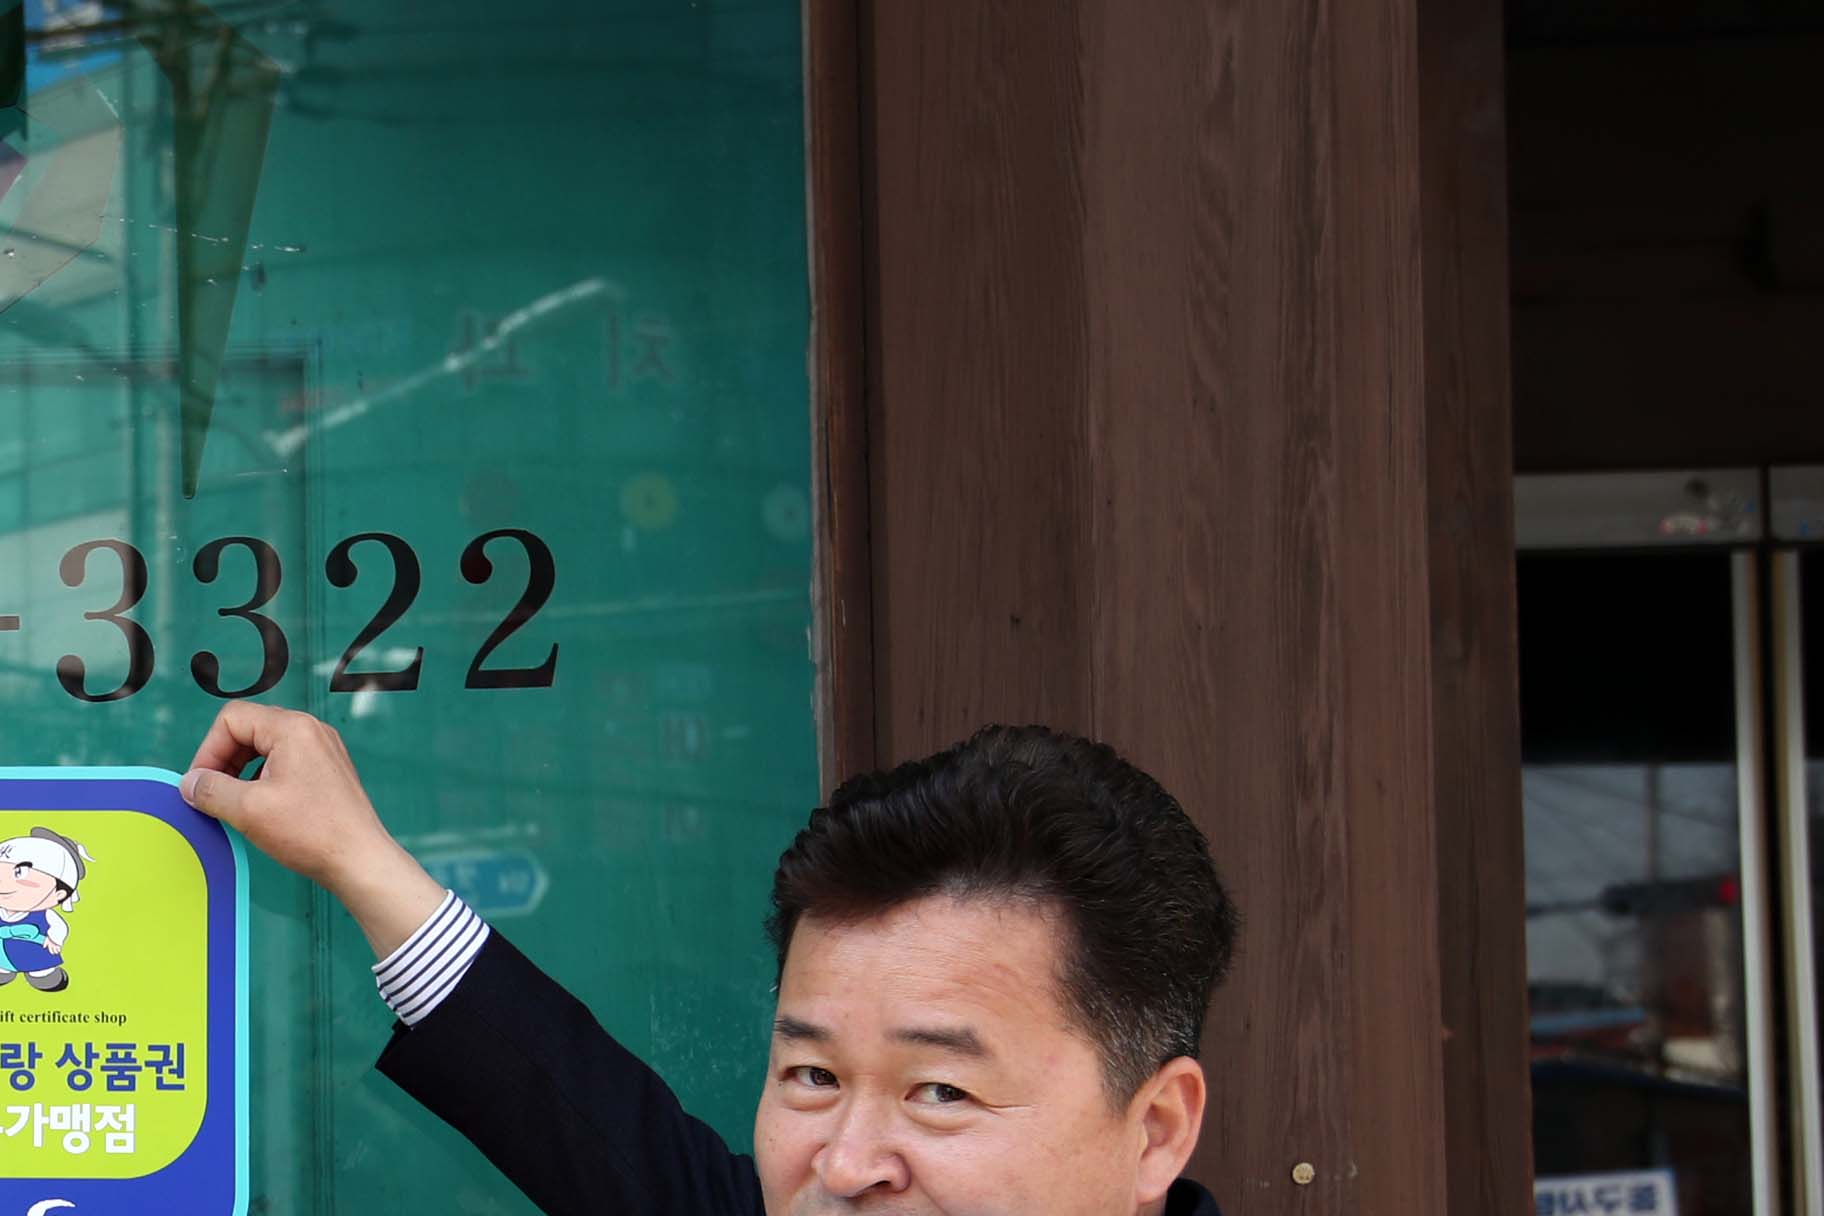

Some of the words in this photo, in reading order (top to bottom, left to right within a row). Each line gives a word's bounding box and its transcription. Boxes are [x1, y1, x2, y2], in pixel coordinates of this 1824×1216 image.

[19, 1011, 90, 1024] certificate
[94, 1011, 127, 1026] shop
[55, 1042, 186, 1092] 상품권
